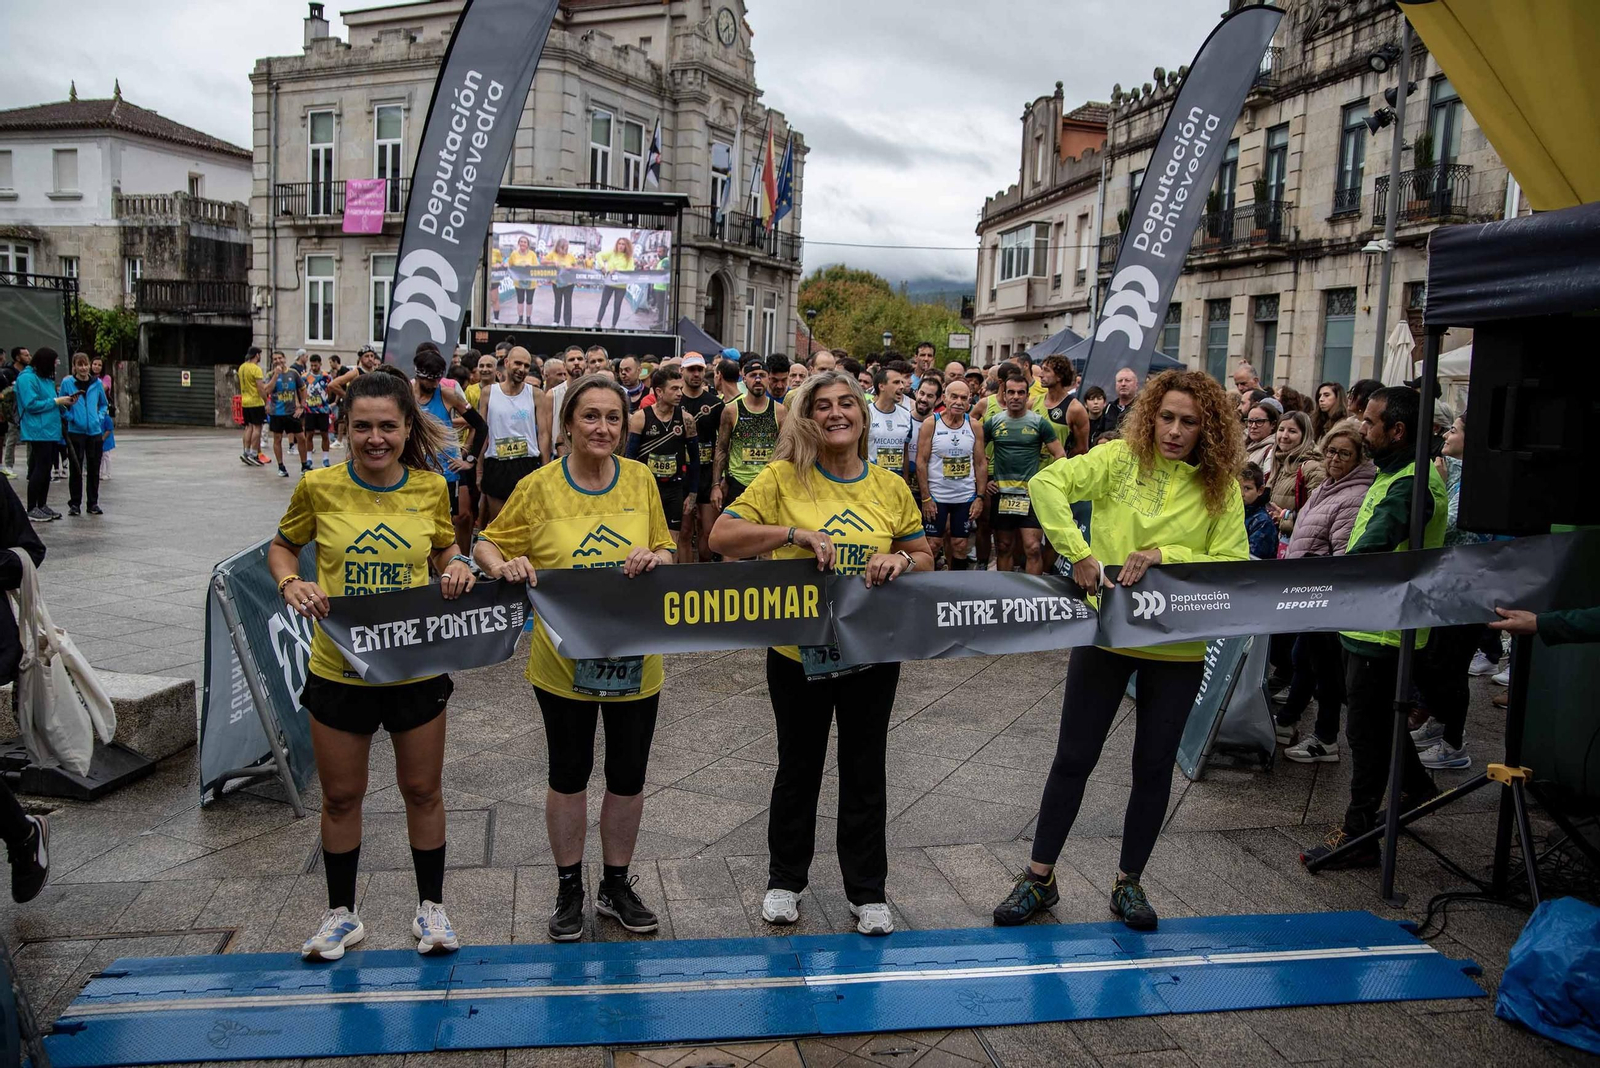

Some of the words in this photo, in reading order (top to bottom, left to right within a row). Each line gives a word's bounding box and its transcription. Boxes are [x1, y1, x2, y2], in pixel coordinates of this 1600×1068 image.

[418, 69, 483, 235] Deputación
[441, 79, 504, 245] Pontevedra
[1132, 105, 1204, 251] Deputación
[1150, 113, 1221, 259] Pontevedra
[507, 444, 518, 452] 44
[750, 449, 767, 457] 244
[654, 462, 670, 470] 468
[887, 455, 895, 463] 15
[951, 464, 965, 472] 239
[1008, 500, 1021, 508] 172
[345, 561, 404, 585] ENTRE
[1170, 590, 1230, 604] Deputación
[1290, 585, 1333, 594] PROVINCIA
[663, 584, 819, 626] GONDOMAR
[936, 599, 998, 627] ENTRE
[1001, 596, 1073, 623] PONTES
[1171, 600, 1231, 612] Pontevedra
[1276, 599, 1330, 610] DEPORTE
[350, 618, 423, 654] ENTRE
[426, 604, 509, 642] PONTES
[816, 648, 841, 664] 76
[595, 664, 627, 680] 770
[1195, 637, 1226, 706] RUNNIN
